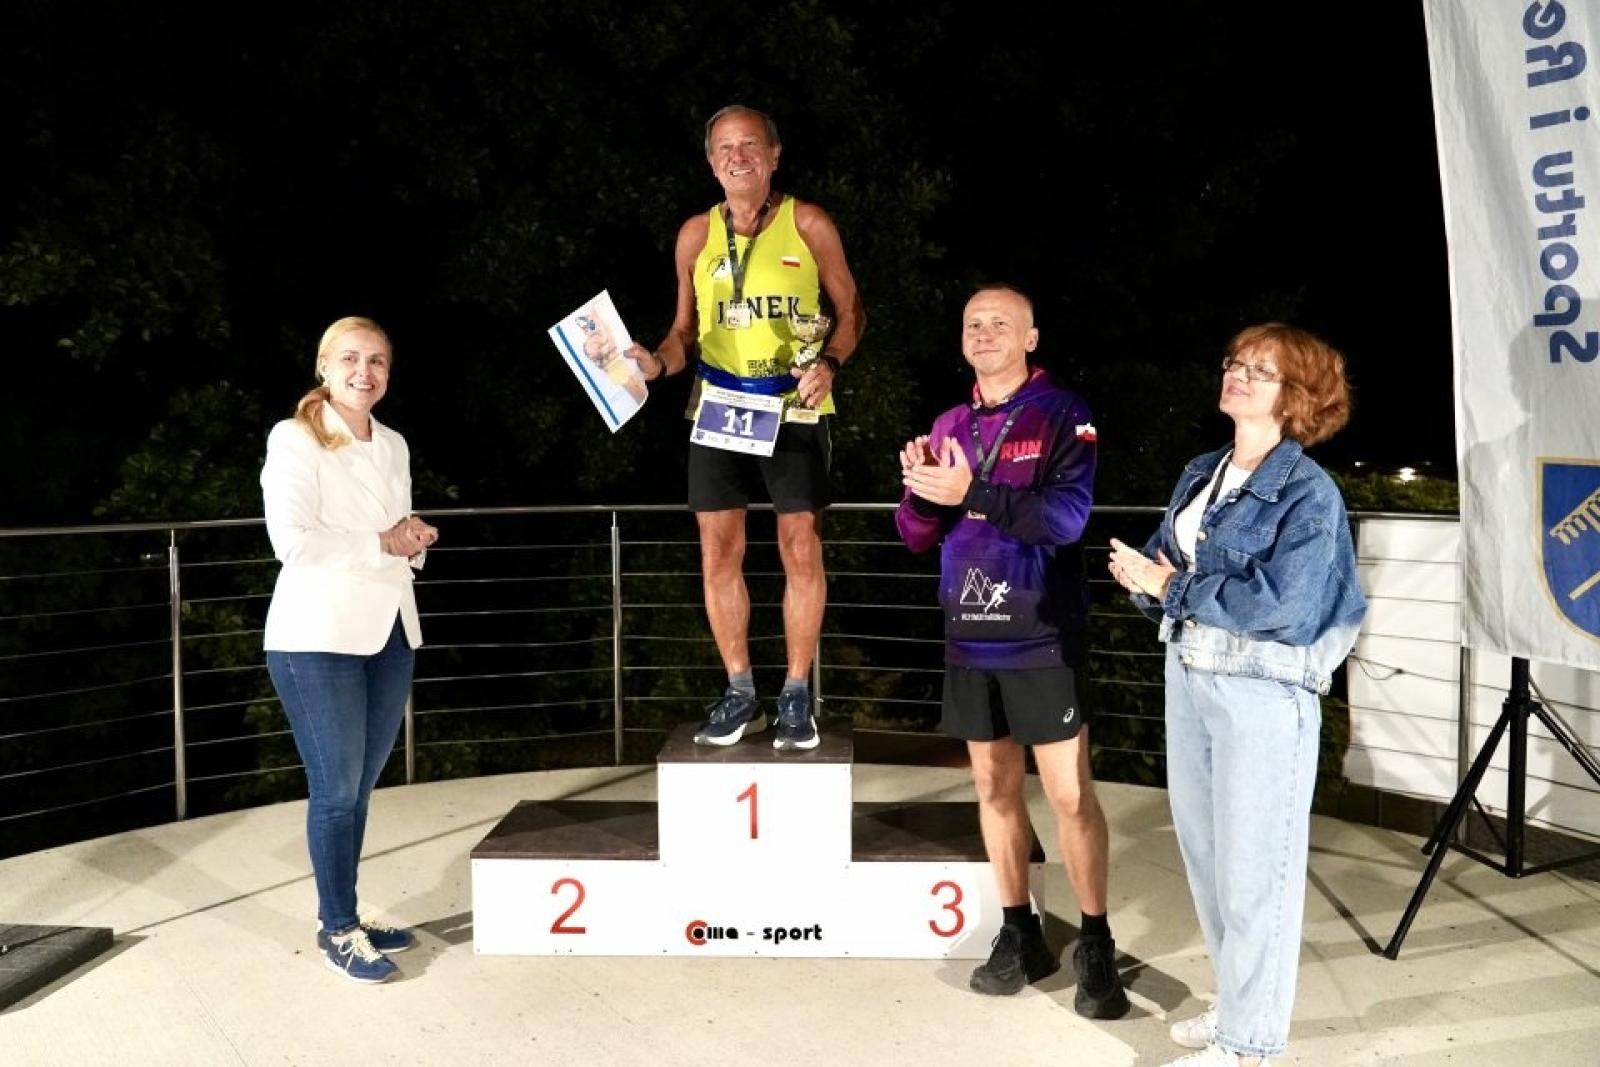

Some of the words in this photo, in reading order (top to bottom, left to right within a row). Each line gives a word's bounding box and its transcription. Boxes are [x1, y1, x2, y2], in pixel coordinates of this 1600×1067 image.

[717, 296, 801, 324] JNEK
[721, 408, 754, 436] 11
[1000, 440, 1042, 459] RUN
[736, 782, 758, 839] 1
[549, 877, 587, 935] 2
[928, 880, 966, 938] 3
[762, 923, 823, 945] sport
